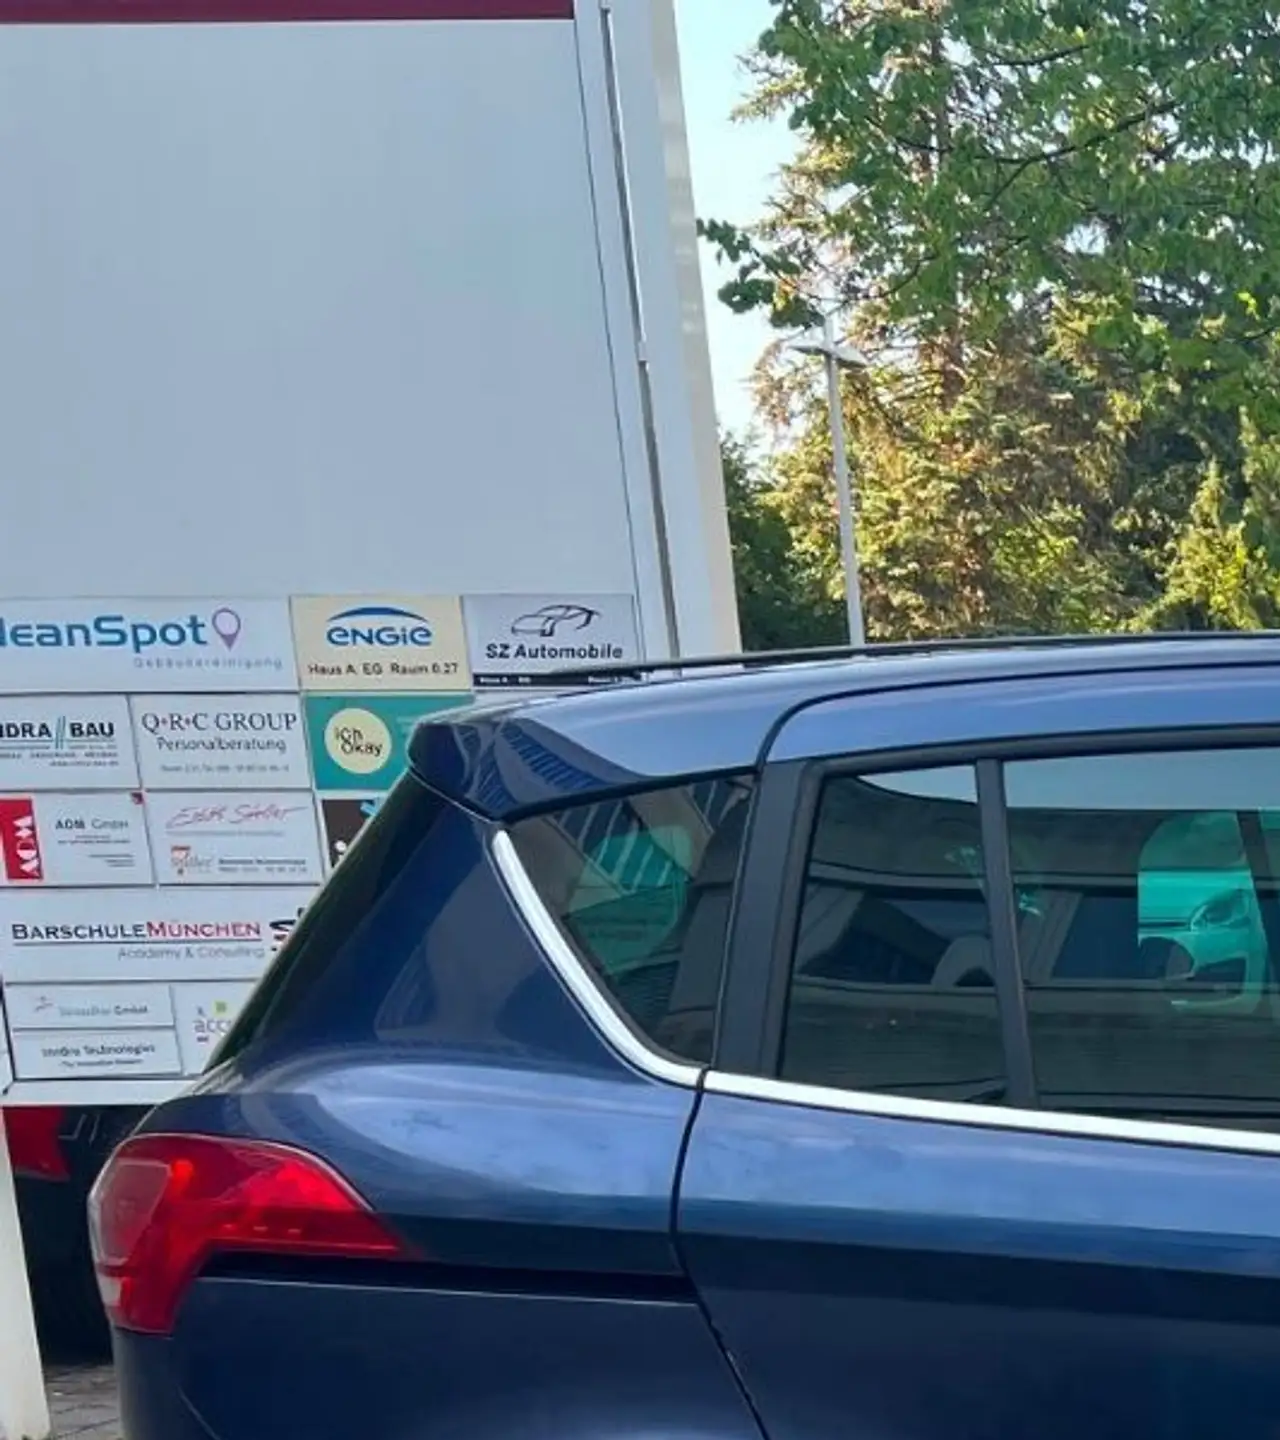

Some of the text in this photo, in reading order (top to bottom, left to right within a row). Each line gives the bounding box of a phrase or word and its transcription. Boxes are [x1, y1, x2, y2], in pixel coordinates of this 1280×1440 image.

[486, 643, 623, 659] SZ Automobile
[214, 712, 297, 731] GROUP
[70, 722, 115, 738] BAU
[157, 737, 287, 754] Personalberatung
